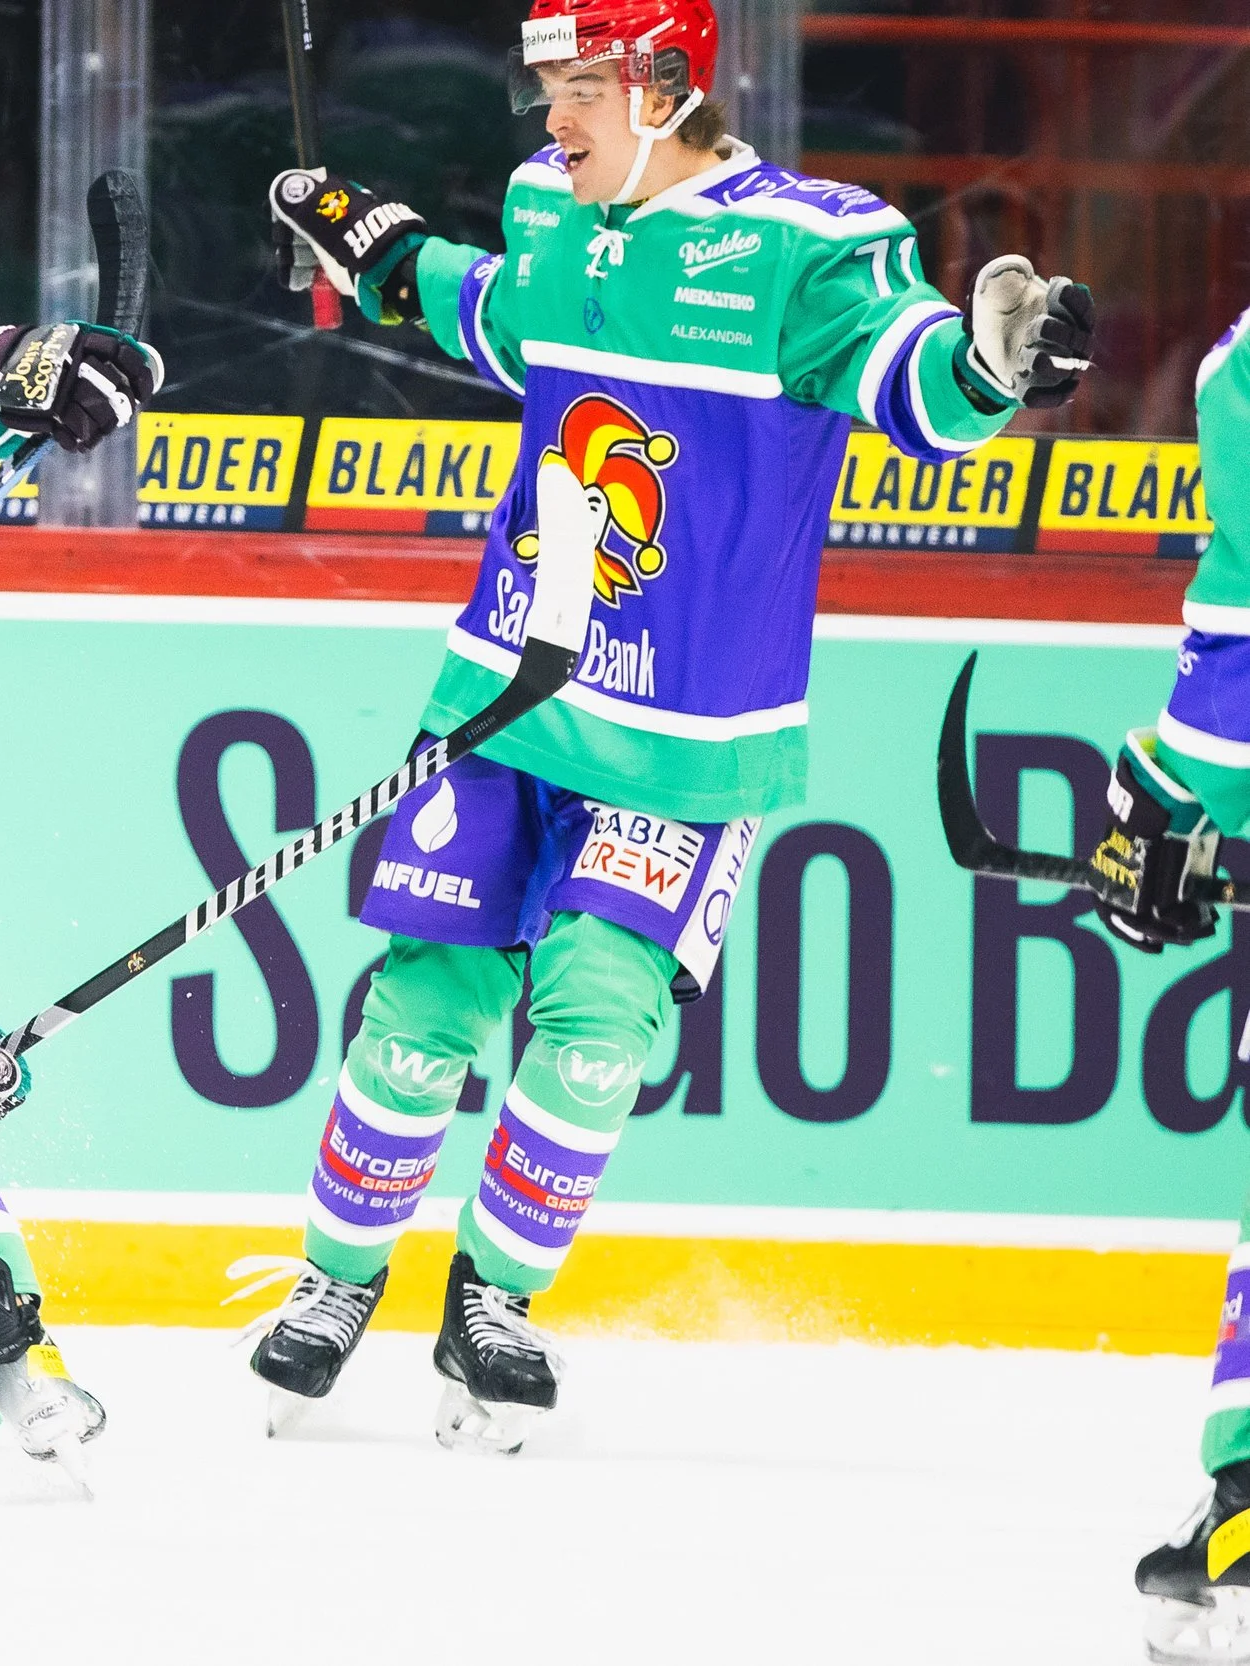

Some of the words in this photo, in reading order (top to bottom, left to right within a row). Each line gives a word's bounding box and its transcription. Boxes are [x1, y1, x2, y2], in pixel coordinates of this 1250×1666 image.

[523, 28, 573, 48] palvelu
[671, 324, 753, 346] ALEXANDRIA
[576, 619, 656, 699] Bank
[185, 739, 449, 944] WARRIOR
[590, 806, 699, 869] CABLE
[581, 842, 681, 894] CREW
